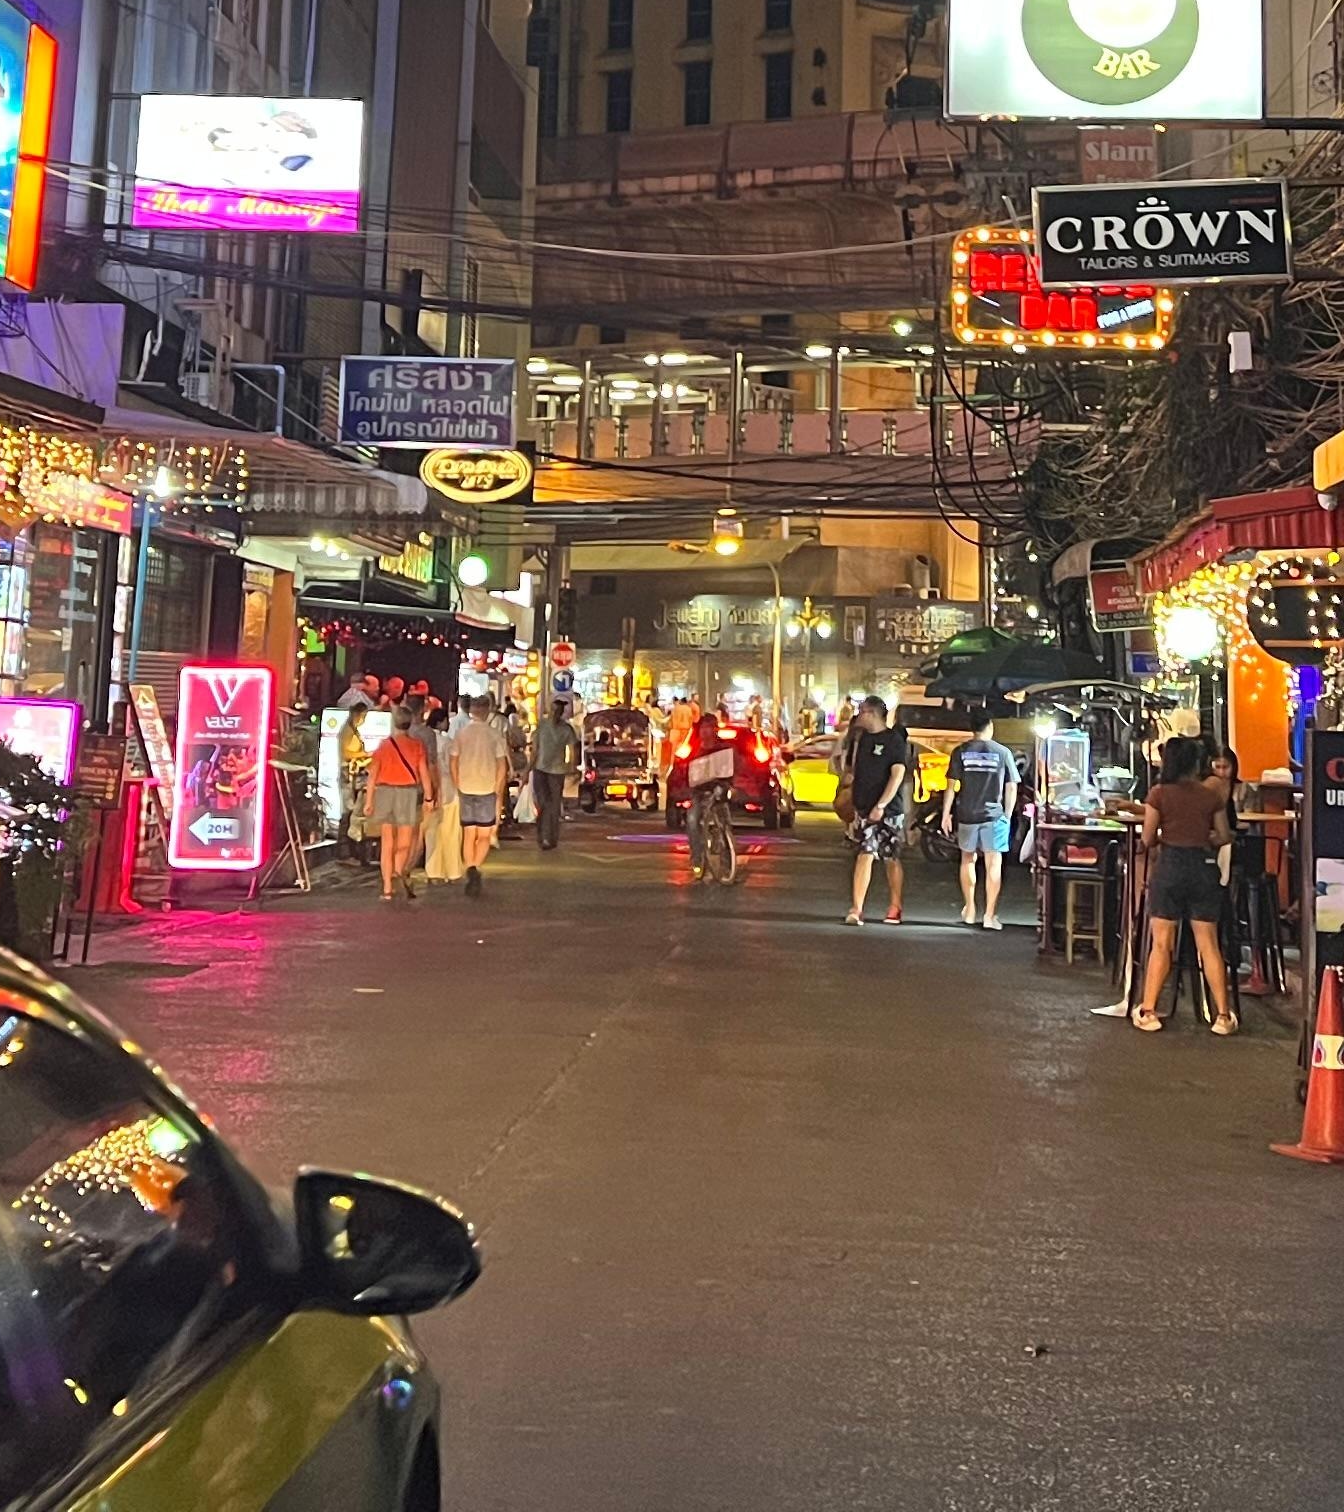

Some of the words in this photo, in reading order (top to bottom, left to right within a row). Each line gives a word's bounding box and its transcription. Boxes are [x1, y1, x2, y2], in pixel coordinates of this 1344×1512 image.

[1092, 47, 1162, 80] BAR
[1045, 208, 1278, 254] CROWN
[1078, 256, 1139, 271] TAILORS
[1143, 257, 1154, 269] &
[1158, 251, 1251, 268] SUITMAKERS
[368, 364, 493, 392] ศรีสง่า
[348, 391, 412, 414] โคมไฟ
[420, 394, 510, 418] หลอดไฟ
[652, 599, 722, 631] Jewelry
[677, 627, 721, 648] mart
